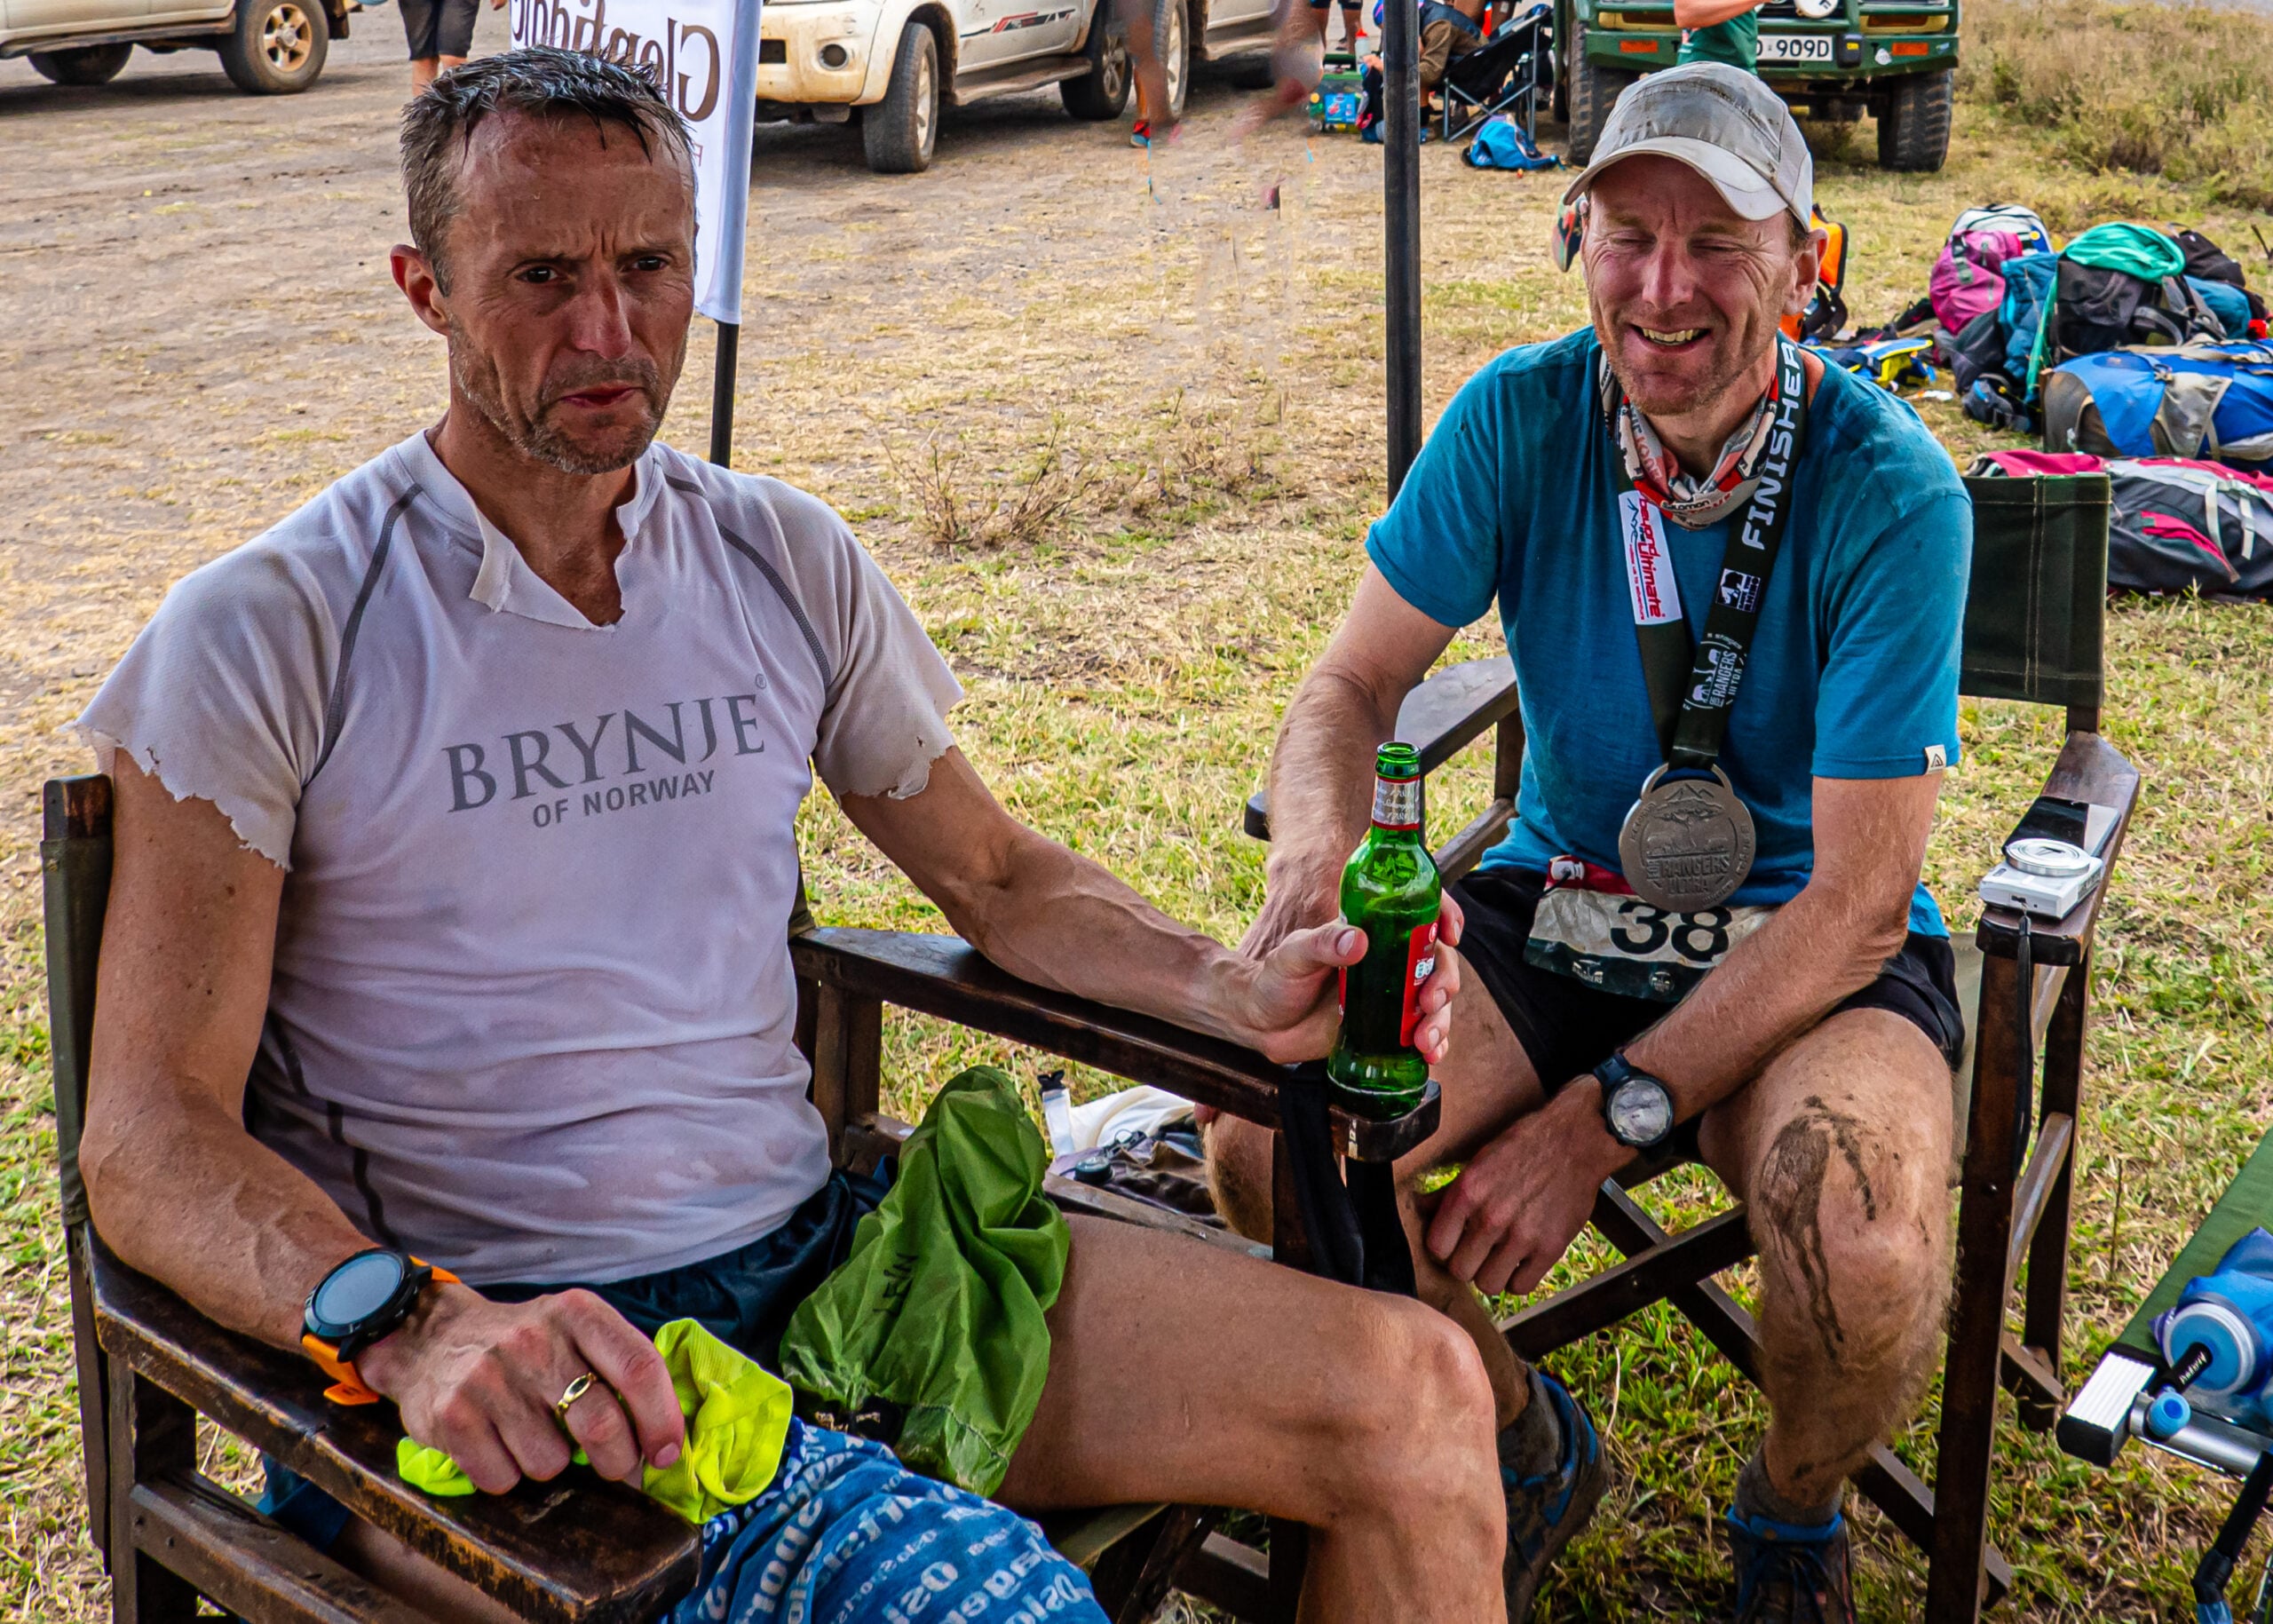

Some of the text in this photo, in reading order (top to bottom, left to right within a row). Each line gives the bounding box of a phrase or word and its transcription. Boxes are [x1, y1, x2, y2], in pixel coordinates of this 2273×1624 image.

[1776, 39, 1830, 58] 909D
[1741, 342, 1801, 551] FINISHER
[1712, 650, 1738, 699] RANGERS
[441, 693, 765, 813] BRYNJE
[533, 769, 715, 828] OF NORWAY
[1662, 853, 1730, 878] RANGERS
[1611, 901, 1732, 963] 38
